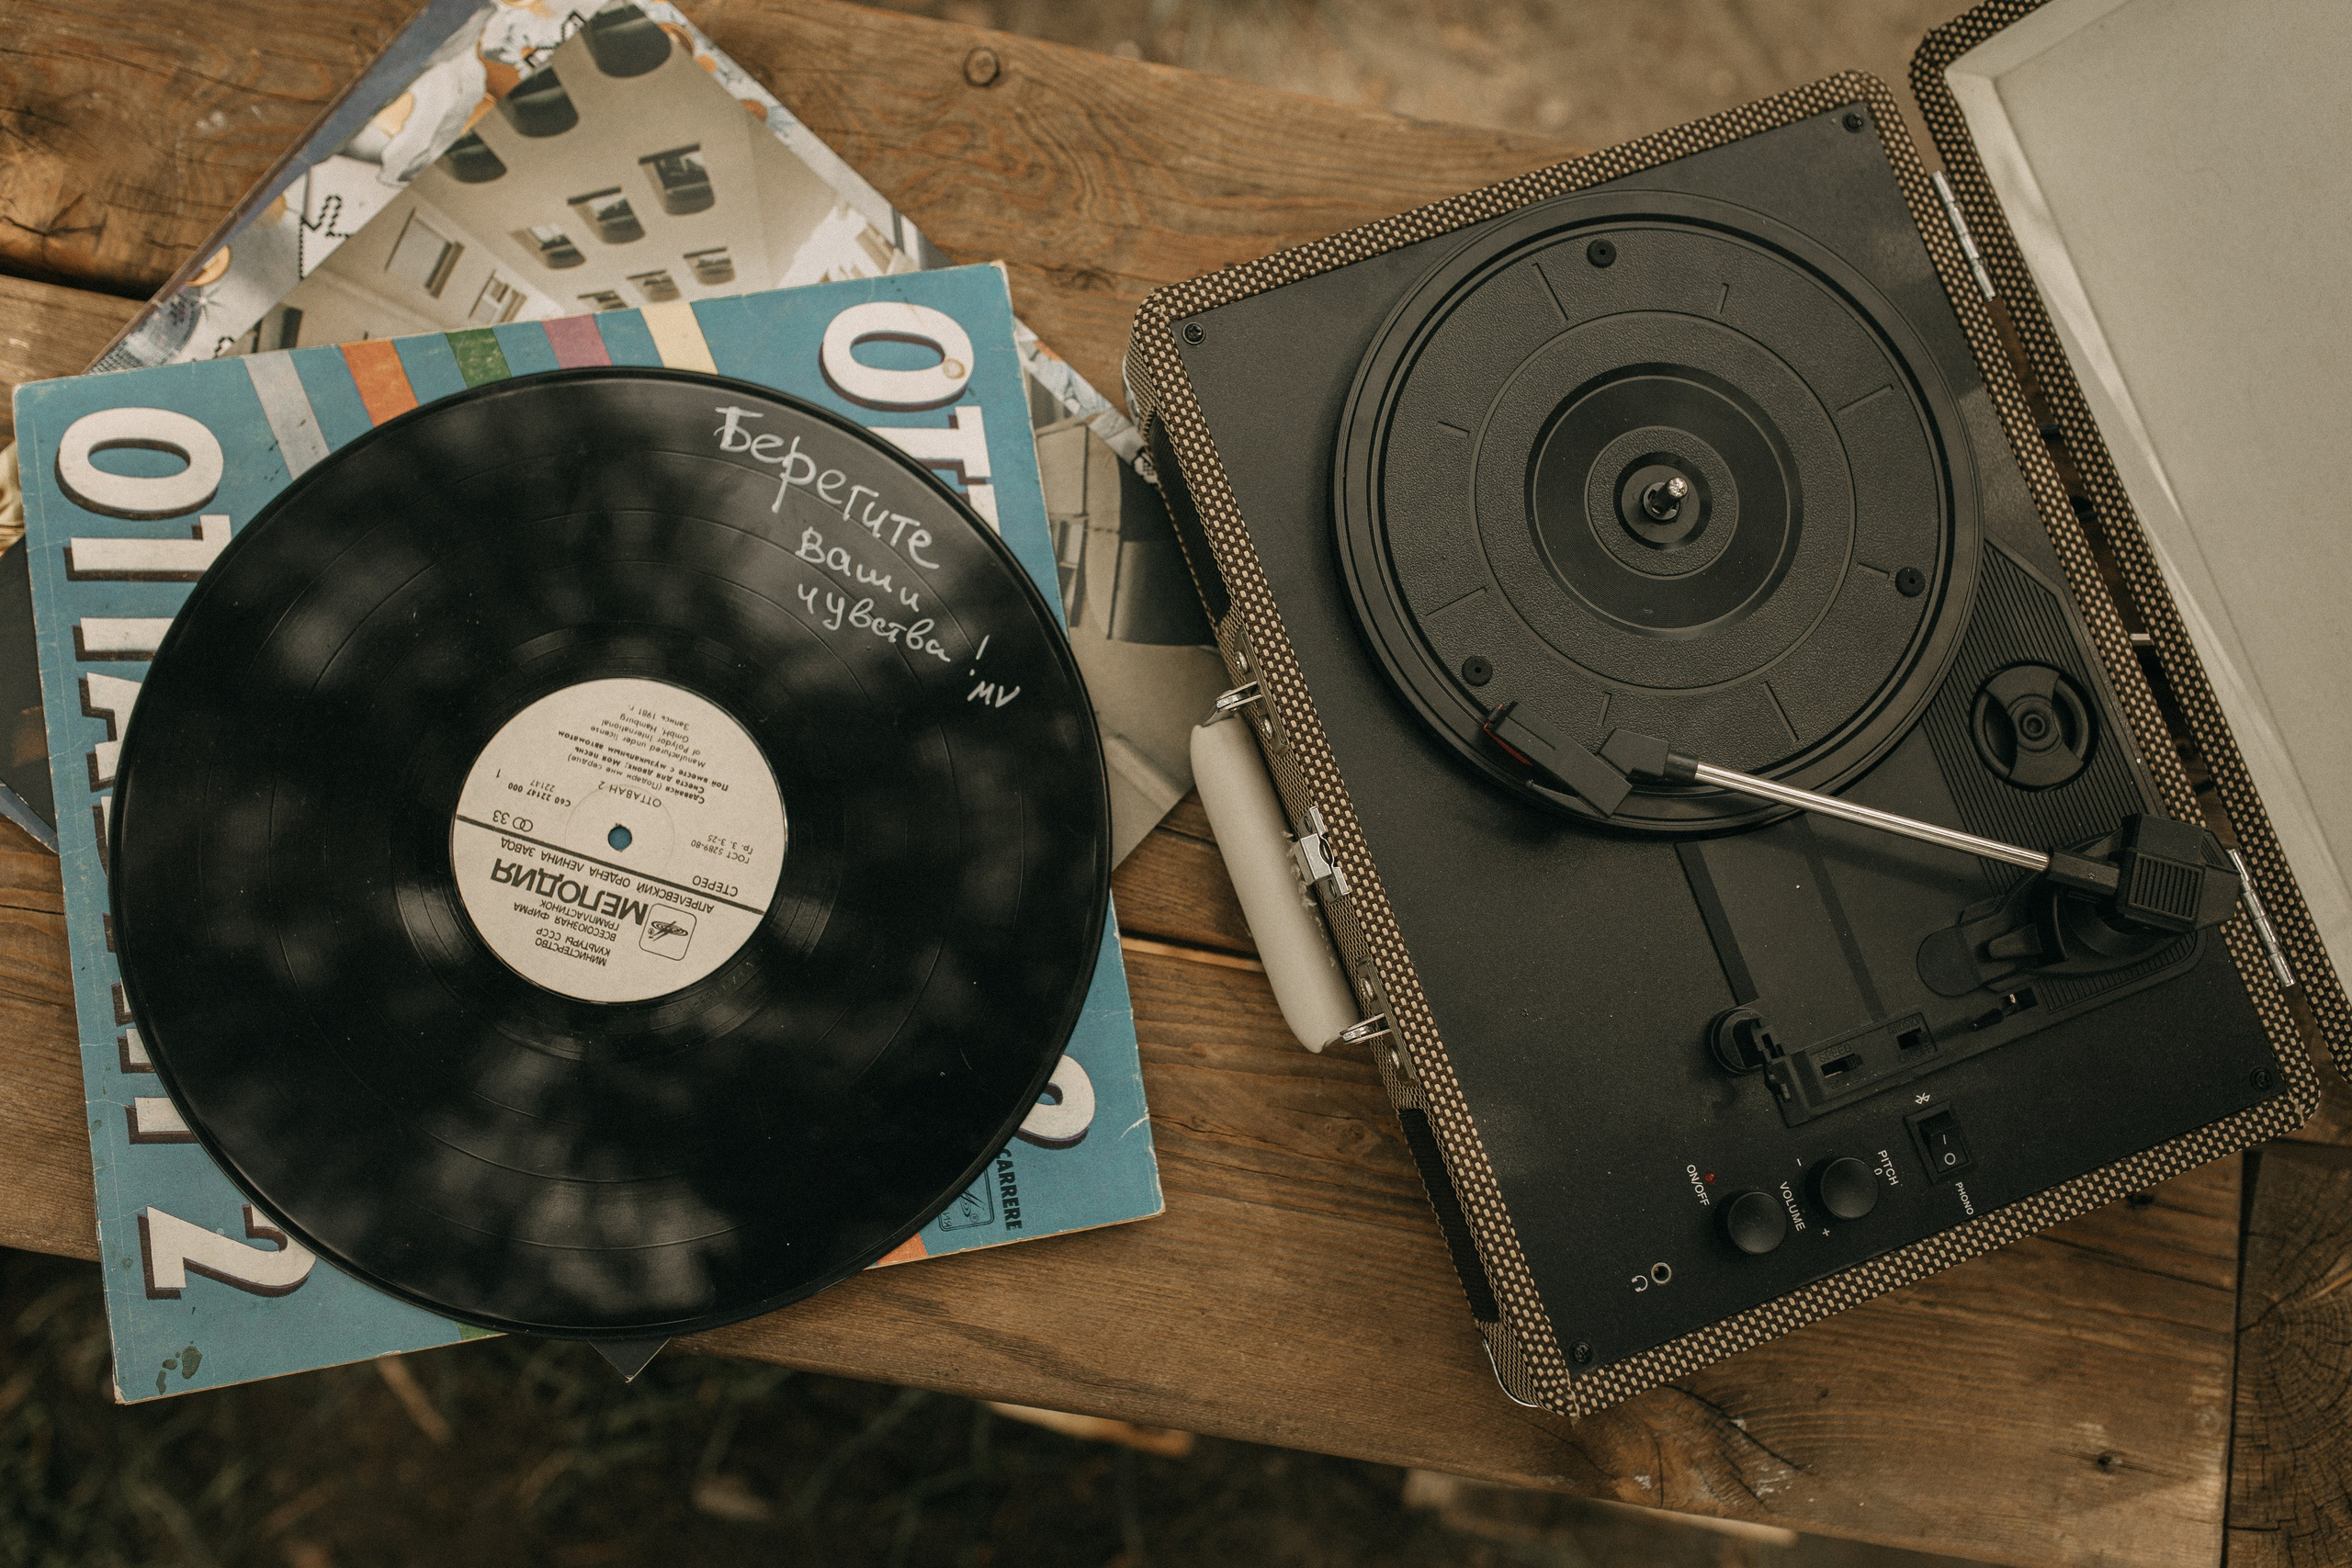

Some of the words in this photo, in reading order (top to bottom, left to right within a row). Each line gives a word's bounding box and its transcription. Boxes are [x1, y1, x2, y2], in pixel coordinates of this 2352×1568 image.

[714, 405, 940, 570] Берегите
[794, 525, 920, 613] ваши
[619, 713, 658, 733] Hamburg
[638, 708, 656, 720] 1981
[661, 715, 690, 731] Запись
[558, 730, 605, 750] автоматом
[590, 725, 619, 741] license
[601, 719, 653, 742] International
[622, 736, 647, 748] under
[657, 737, 690, 754] Polydor
[574, 746, 600, 760] песнь
[601, 755, 622, 767] Моя
[607, 746, 667, 770] музыкальным
[649, 744, 707, 769] Manufactured
[605, 766, 623, 776] мне
[624, 761, 654, 776] двоих;
[655, 772, 673, 783] для
[678, 769, 709, 784] вместе
[507, 782, 524, 794] 000
[529, 779, 556, 793] 22147
[626, 773, 662, 791] (Подари
[710, 780, 729, 793] Пой
[526, 788, 552, 802] 22147
[608, 784, 662, 808] ОТТАВАН
[664, 785, 706, 805] Сдавайся
[492, 809, 511, 826] 33
[501, 836, 537, 858] ЗАВОД
[690, 839, 724, 856] 5289-80
[707, 834, 727, 847] 3-25
[741, 844, 754, 855] Гр.
[540, 850, 585, 873] ЛЕНИНА
[726, 851, 751, 864] ГОСТ
[589, 865, 631, 888] ОРДЕНА
[692, 874, 739, 898] СТЕРЕО
[489, 857, 650, 927] МЕЛОДИЯ
[636, 881, 716, 915] АПРЕЛЕВСКИЙ
[513, 901, 550, 920] ФИРМА
[538, 898, 620, 932] ГРАМПЛАСТИНОК
[535, 927, 562, 942] СССР
[553, 915, 617, 942] ВСЕСОЮЗНАЯ
[534, 937, 608, 967] МИНИСТЕРСТВО
[564, 935, 612, 957] КУЛЬТУРЫ
[1877, 1149, 1899, 1186] PITCH
[995, 1147, 1023, 1231] CARRERE
[1686, 1164, 1711, 1207] ON/OFF
[1780, 1180, 1806, 1232] VOLUME
[1955, 1181, 1974, 1215] PHONO
